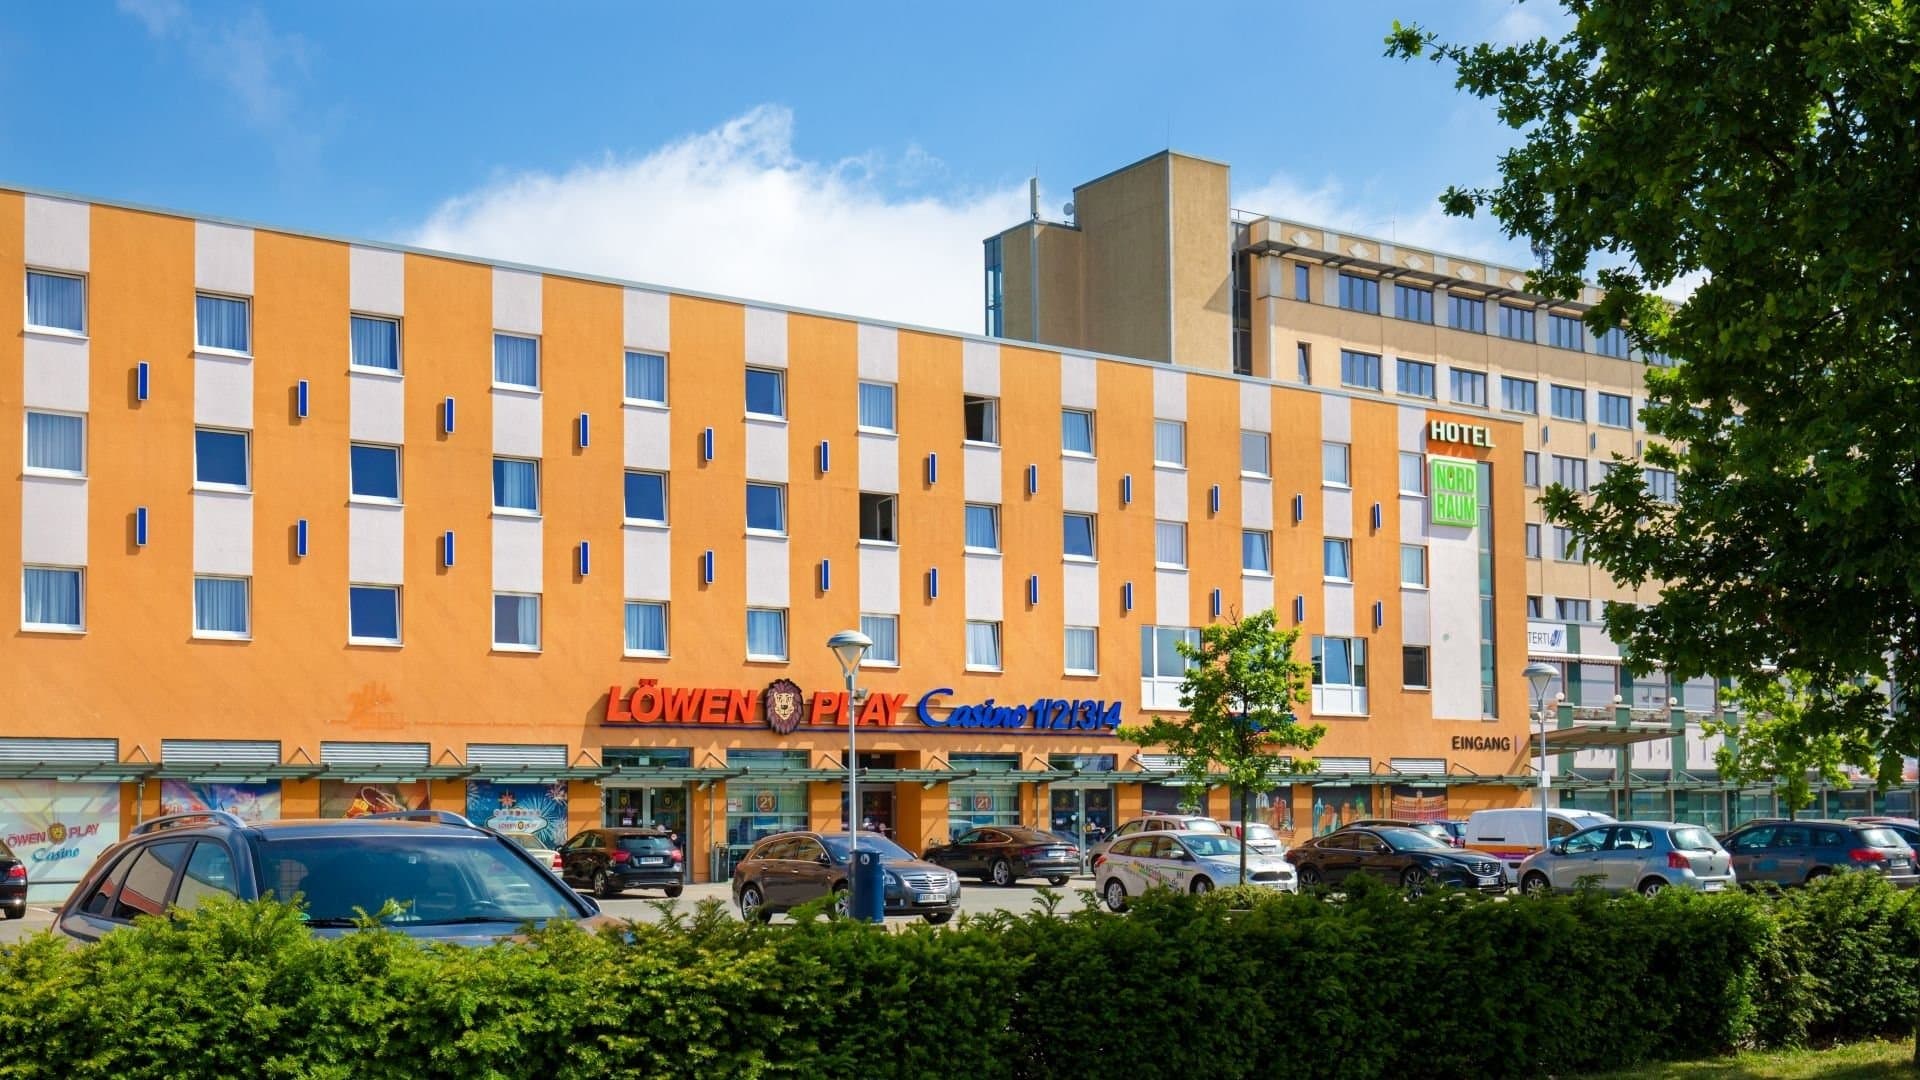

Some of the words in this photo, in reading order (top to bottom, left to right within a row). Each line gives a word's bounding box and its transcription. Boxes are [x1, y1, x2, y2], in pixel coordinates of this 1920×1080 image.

[1430, 419, 1496, 448] HOTEL
[1437, 463, 1475, 493] NORD
[1437, 493, 1475, 520] RAUM
[605, 678, 758, 724] LÖWEN
[810, 690, 908, 727] PLAY
[916, 687, 1028, 728] Casino
[1451, 735, 1511, 752] EINGANG
[759, 796, 774, 809] 21
[976, 797, 990, 810] 21
[7, 831, 46, 849] ÖWEN
[68, 823, 99, 839] PLAY
[31, 847, 80, 862] Casino
